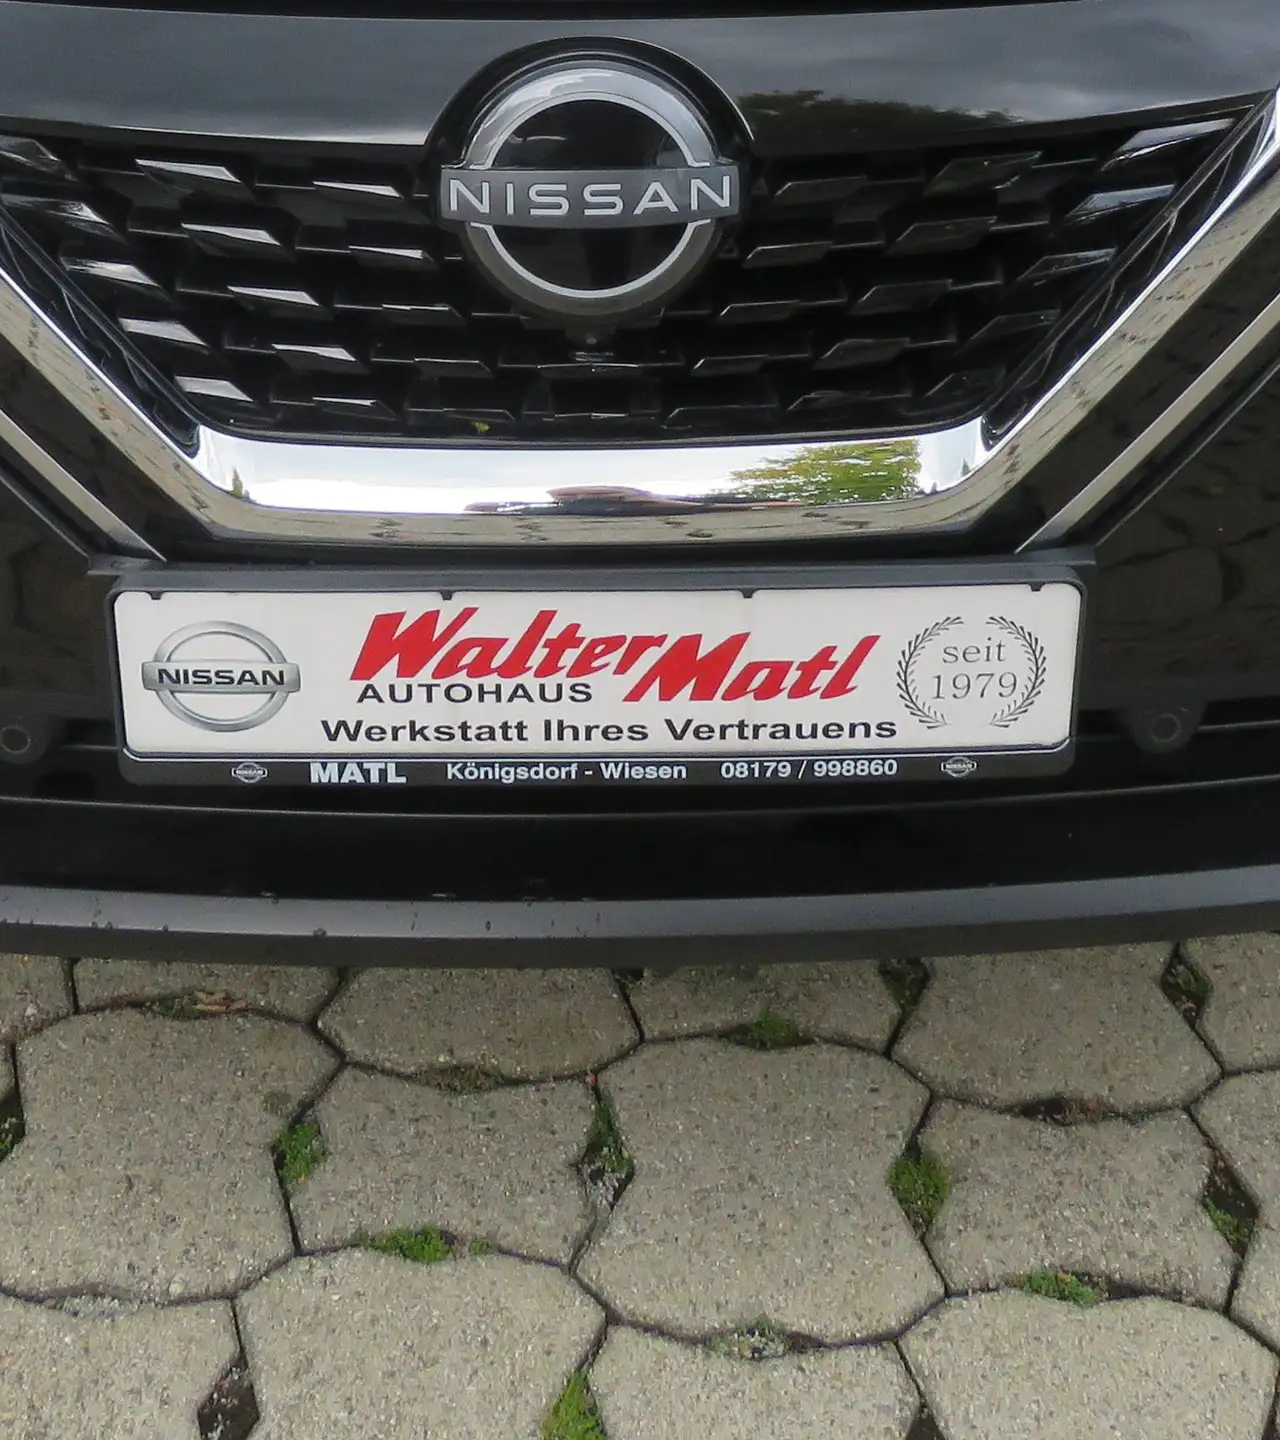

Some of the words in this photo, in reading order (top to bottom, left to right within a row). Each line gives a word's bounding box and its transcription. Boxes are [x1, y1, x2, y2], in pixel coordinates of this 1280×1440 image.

[449, 175, 731, 215] NISSAN
[349, 606, 668, 681] Walter
[622, 631, 882, 703] Matl
[941, 637, 1007, 664] seit
[157, 668, 285, 686] NISSAN
[931, 671, 1018, 701] 1979
[356, 682, 593, 704] AUTOHAUS
[321, 719, 529, 743] Werkstatt
[544, 718, 649, 742] Ihres
[664, 717, 898, 742] Vertrauens
[309, 761, 407, 784] MATL
[446, 762, 578, 783] Königsdorf
[600, 762, 687, 780] Wiesen
[720, 761, 792, 779] 08179
[796, 760, 807, 780] /
[813, 760, 898, 777] 998860
